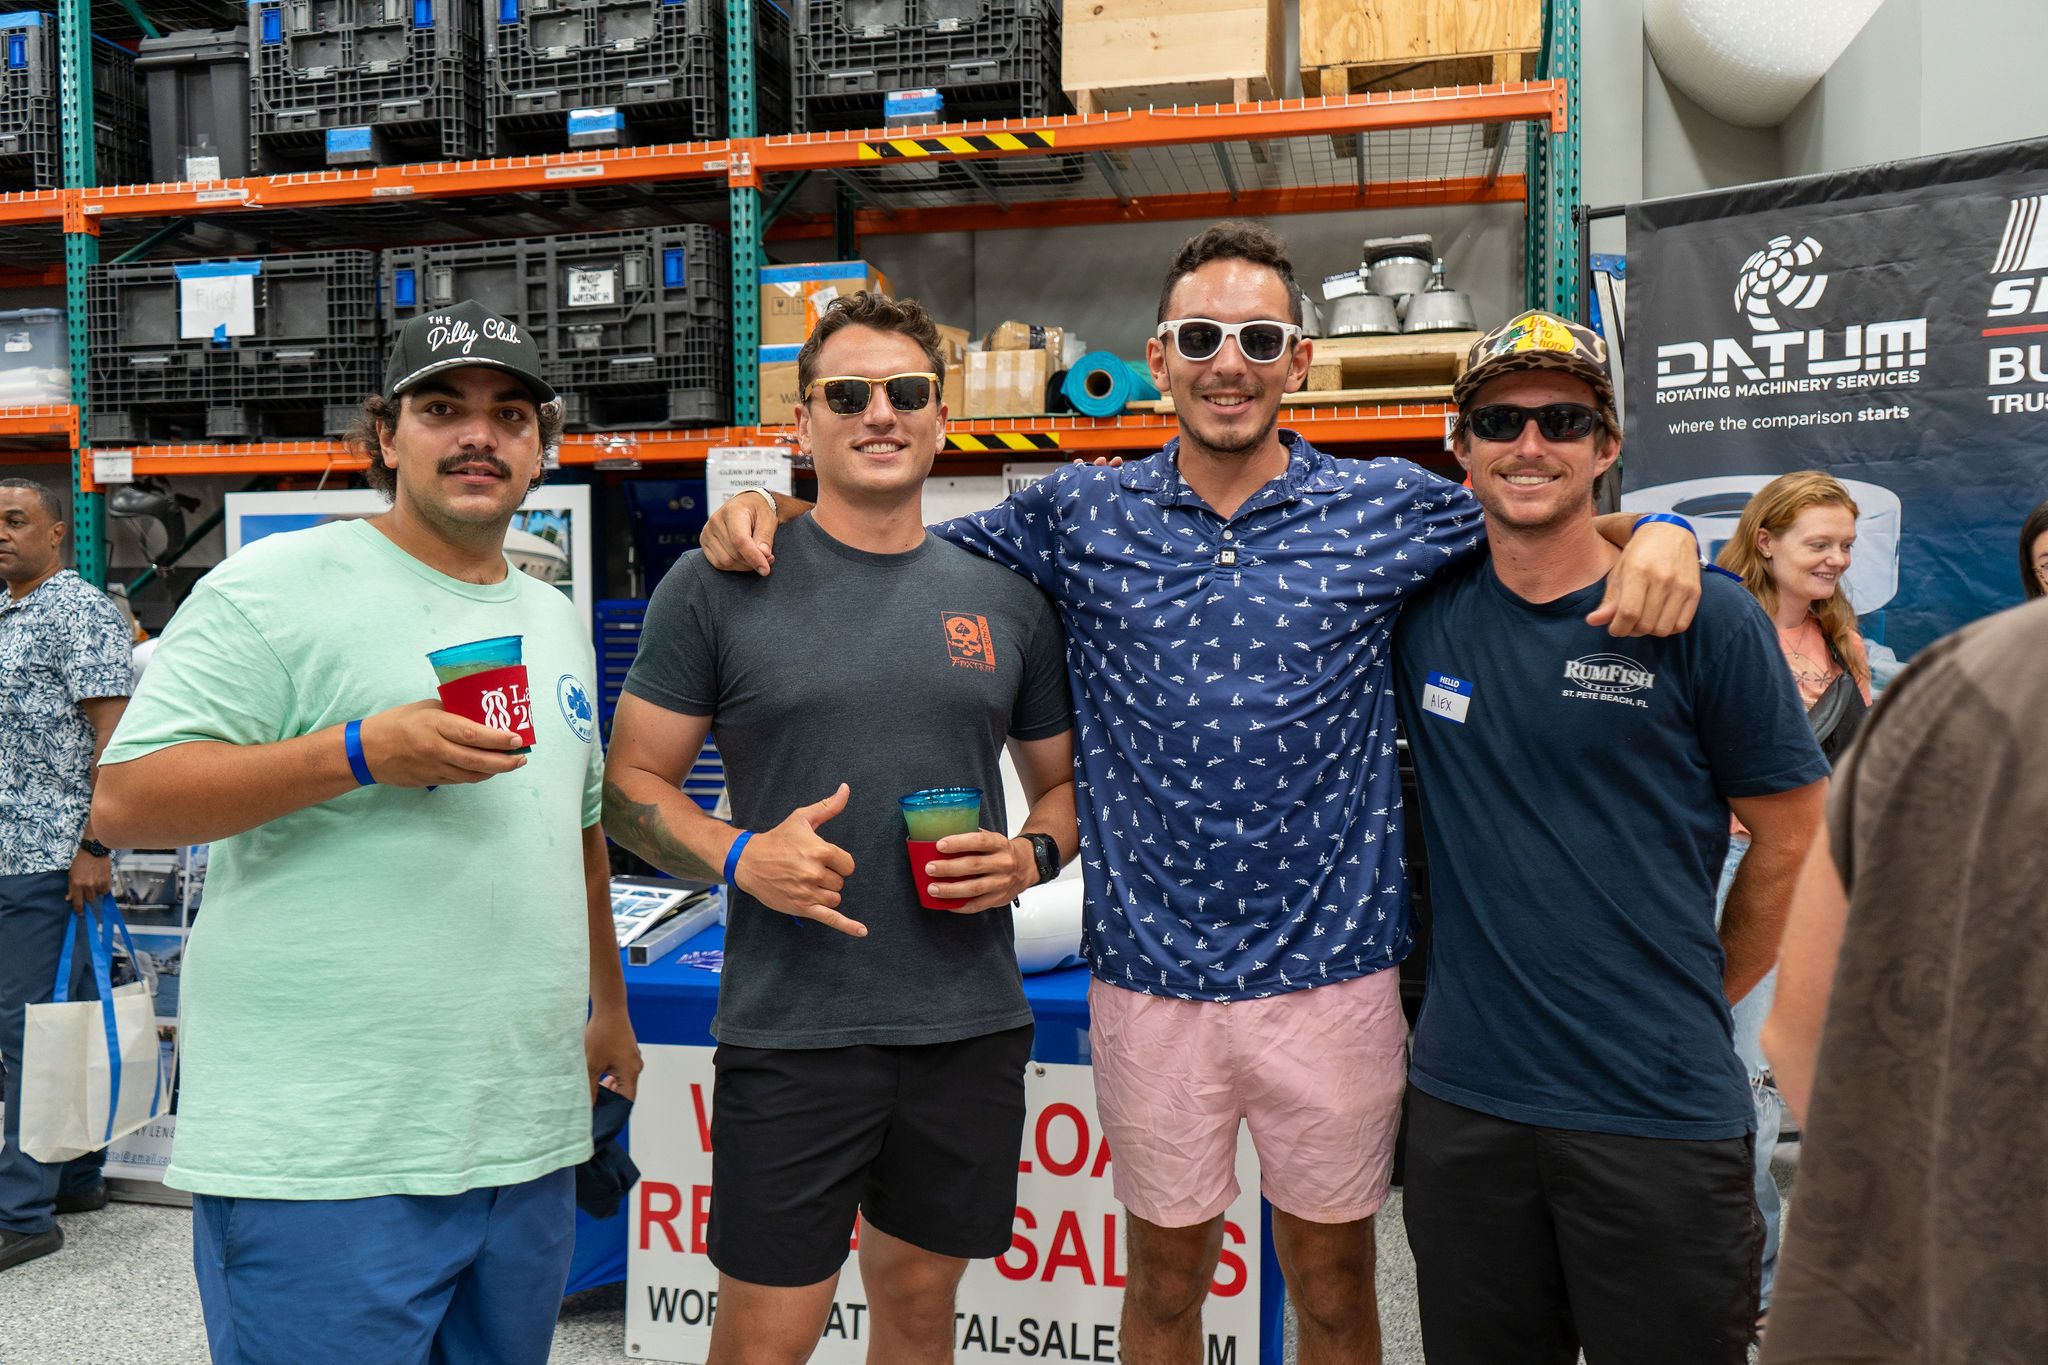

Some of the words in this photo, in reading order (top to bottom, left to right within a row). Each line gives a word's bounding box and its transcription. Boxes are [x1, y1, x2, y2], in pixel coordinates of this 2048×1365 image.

[572, 291, 610, 303] WRENCH
[428, 315, 452, 325] THE
[427, 320, 479, 354] Dilly
[483, 318, 521, 343] Club
[1657, 318, 1927, 389] DATUM
[1656, 385, 1731, 404] ROTATING
[1735, 378, 1832, 398] MACHINERY
[1836, 369, 1920, 390] SERVICES
[1668, 420, 1715, 435] where
[1719, 416, 1748, 431] the
[1752, 410, 1853, 431] comparison
[1857, 404, 1910, 422] starts
[1439, 675, 1460, 688] HELLO
[1562, 689, 1575, 698] ST.
[1576, 691, 1599, 700] PETE
[1600, 693, 1635, 706] BEACH,
[1637, 699, 1649, 708] FL
